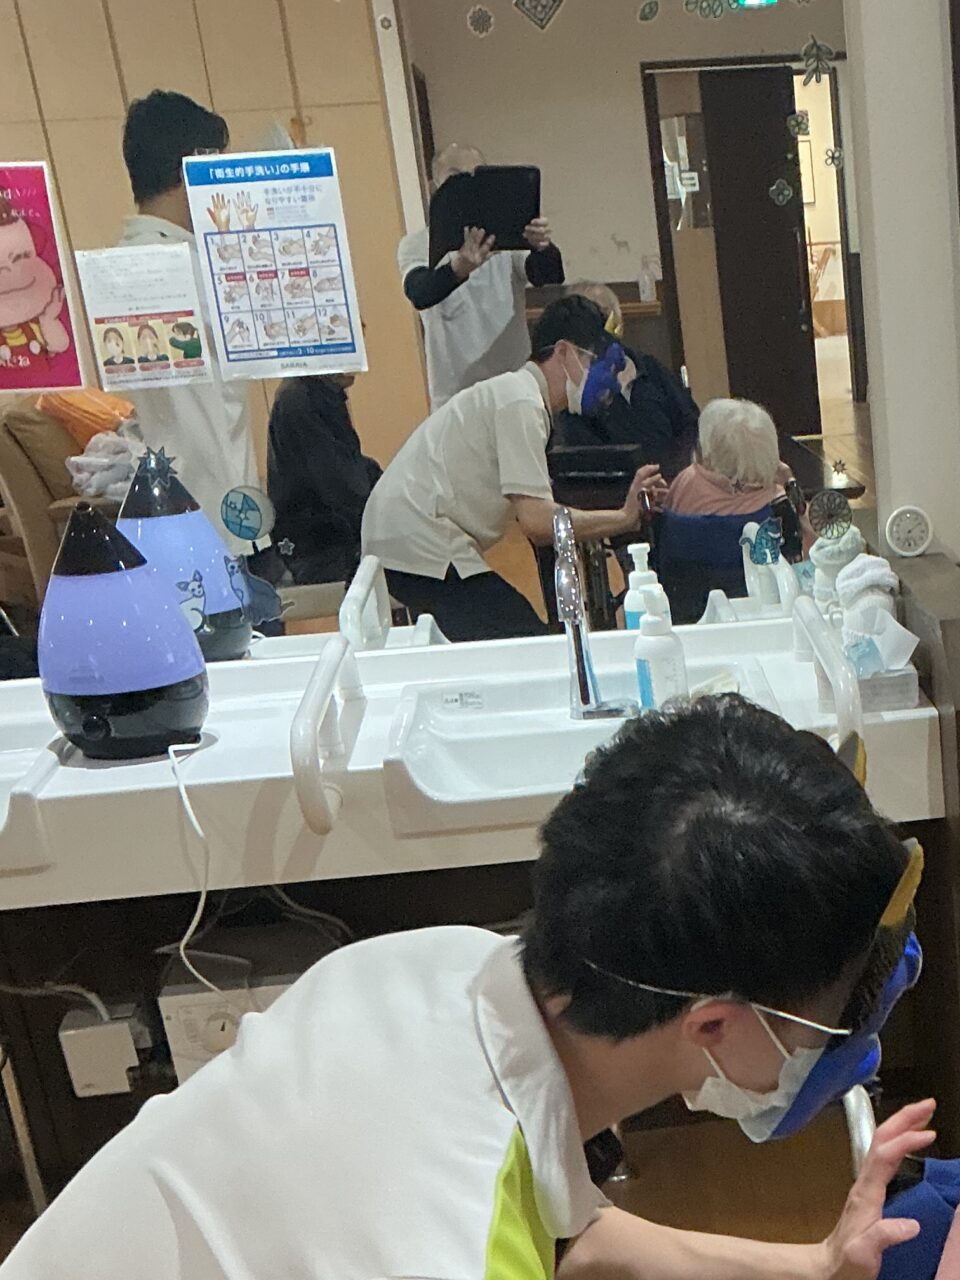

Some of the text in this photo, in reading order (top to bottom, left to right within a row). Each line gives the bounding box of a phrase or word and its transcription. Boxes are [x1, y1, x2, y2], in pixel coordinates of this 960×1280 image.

[255, 313, 265, 321] 10
[286, 311, 296, 319] 11
[318, 309, 328, 317] 12
